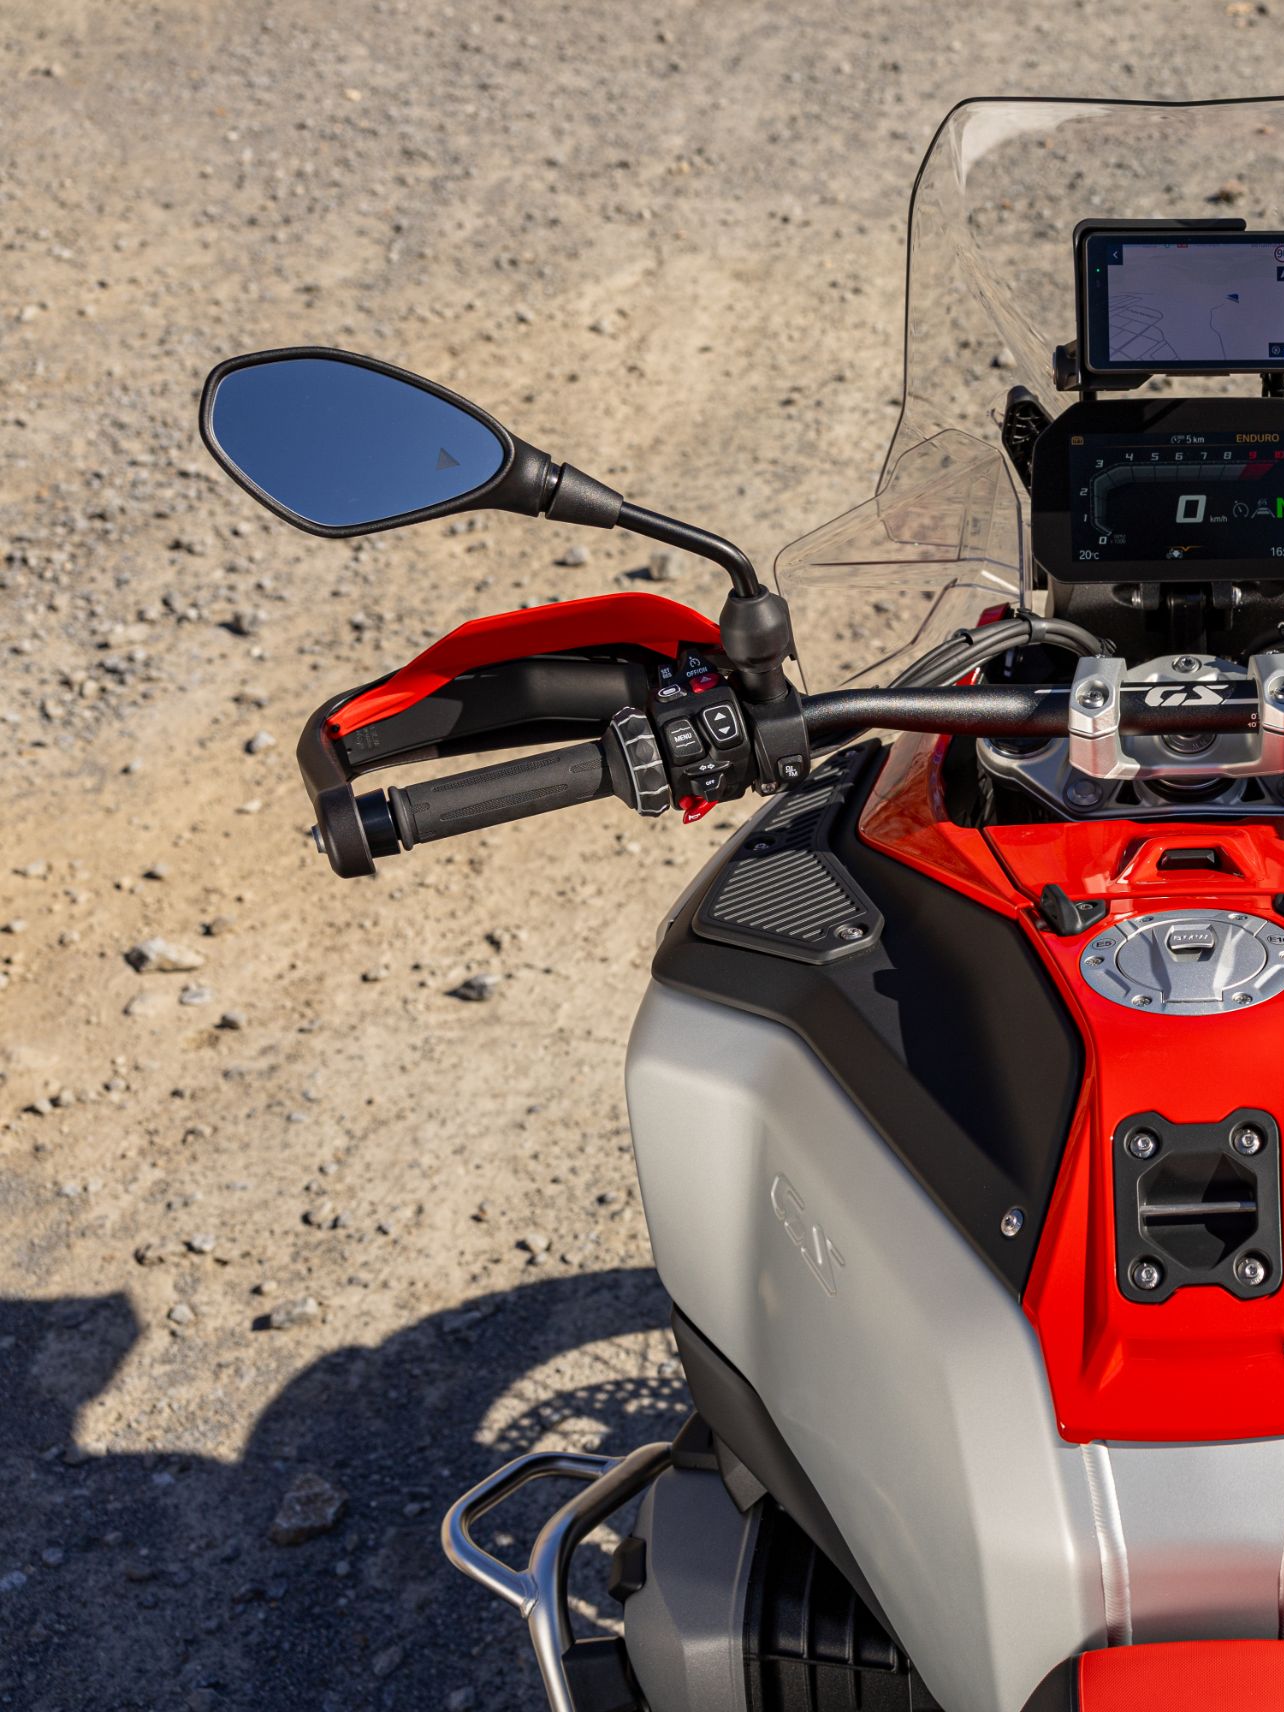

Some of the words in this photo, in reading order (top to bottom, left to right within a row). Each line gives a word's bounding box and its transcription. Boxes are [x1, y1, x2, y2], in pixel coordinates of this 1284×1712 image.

[1186, 435, 1192, 444] 5
[1192, 435, 1205, 444] km
[1236, 433, 1280, 443] ENDURO
[1125, 452, 1134, 461] 4
[1151, 452, 1160, 461] 5
[1175, 452, 1184, 461] 6
[1200, 451, 1208, 460] 7
[1223, 451, 1232, 460] 8
[1248, 450, 1257, 459] 9
[1095, 459, 1104, 468] 3
[1080, 487, 1089, 496] 2
[1175, 494, 1207, 524] 0
[1209, 515, 1228, 523] km/h
[1098, 536, 1108, 545] 0
[1144, 685, 1229, 707] GS
[673, 732, 693, 742] MENU
